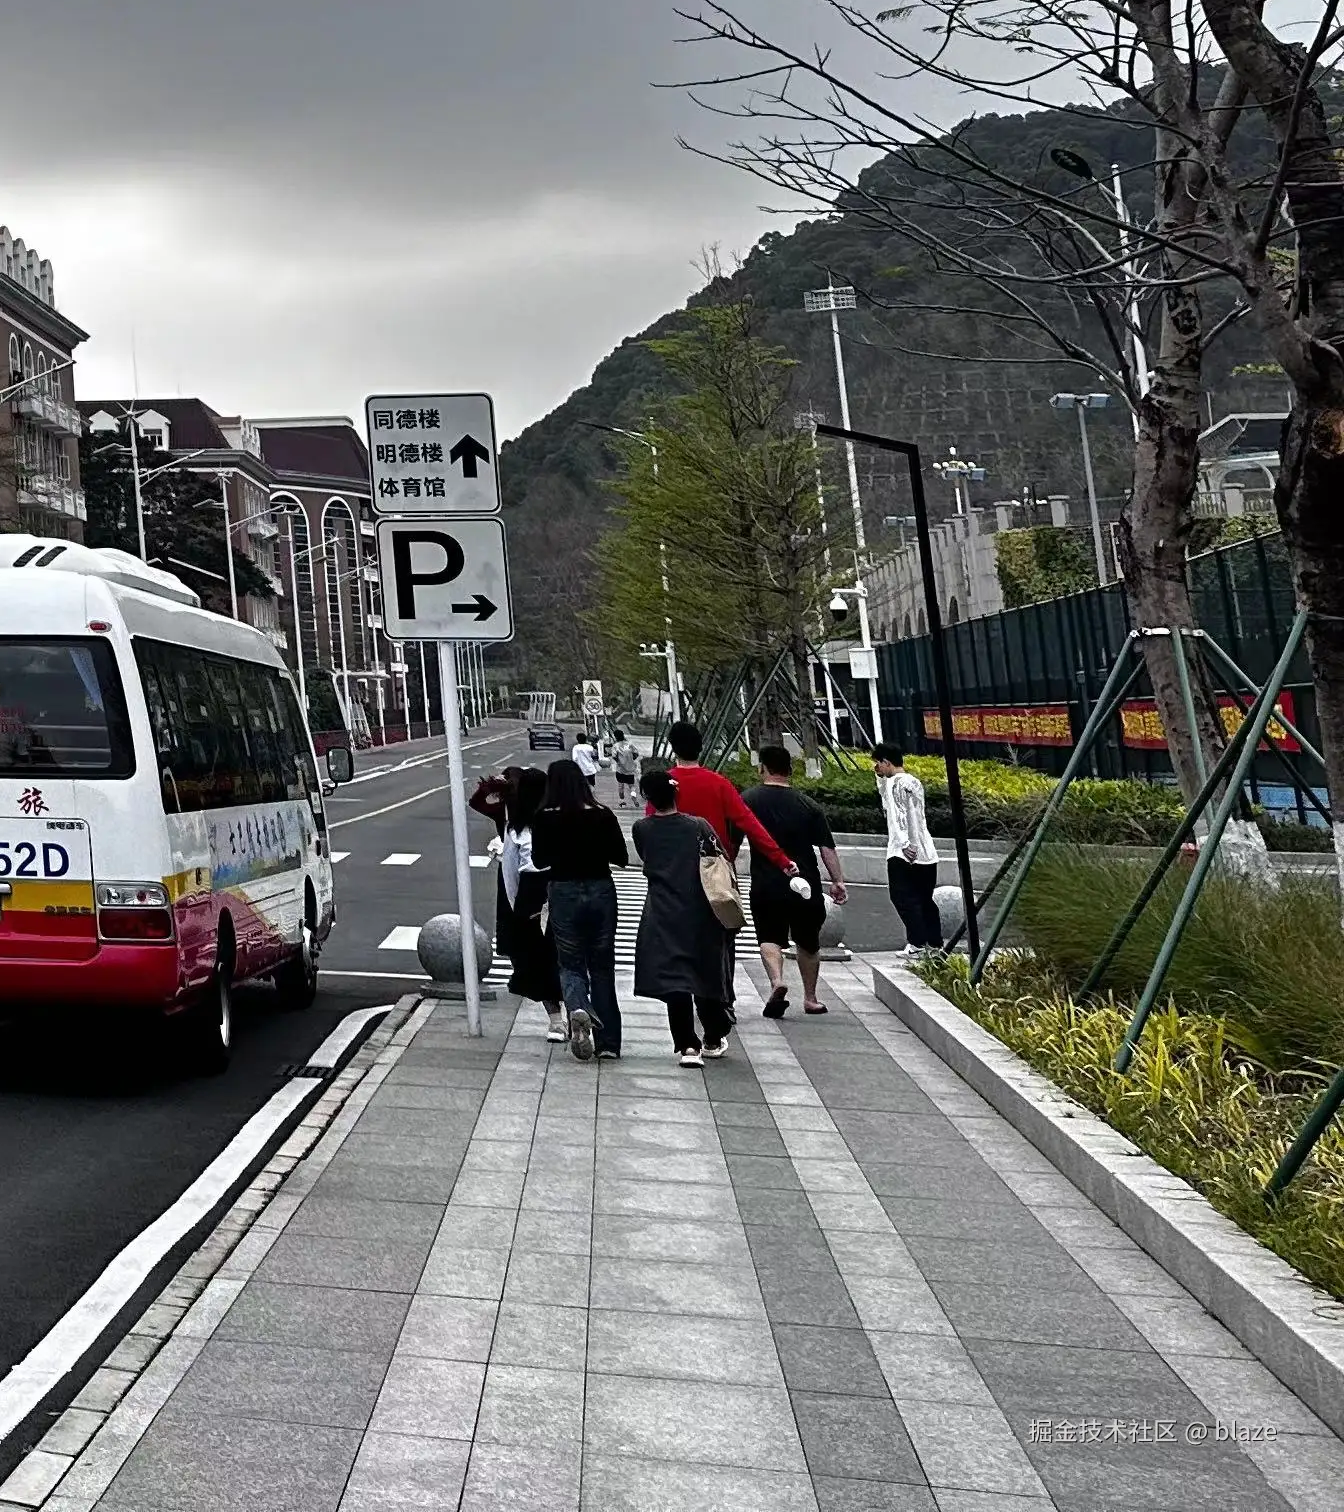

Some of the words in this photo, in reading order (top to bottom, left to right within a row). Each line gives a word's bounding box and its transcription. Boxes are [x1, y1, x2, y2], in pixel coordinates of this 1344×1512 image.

[373, 409, 441, 430] 同德楼
[376, 443, 444, 464] 明德楼
[378, 477, 446, 498] 体育馆
[392, 530, 465, 620] P
